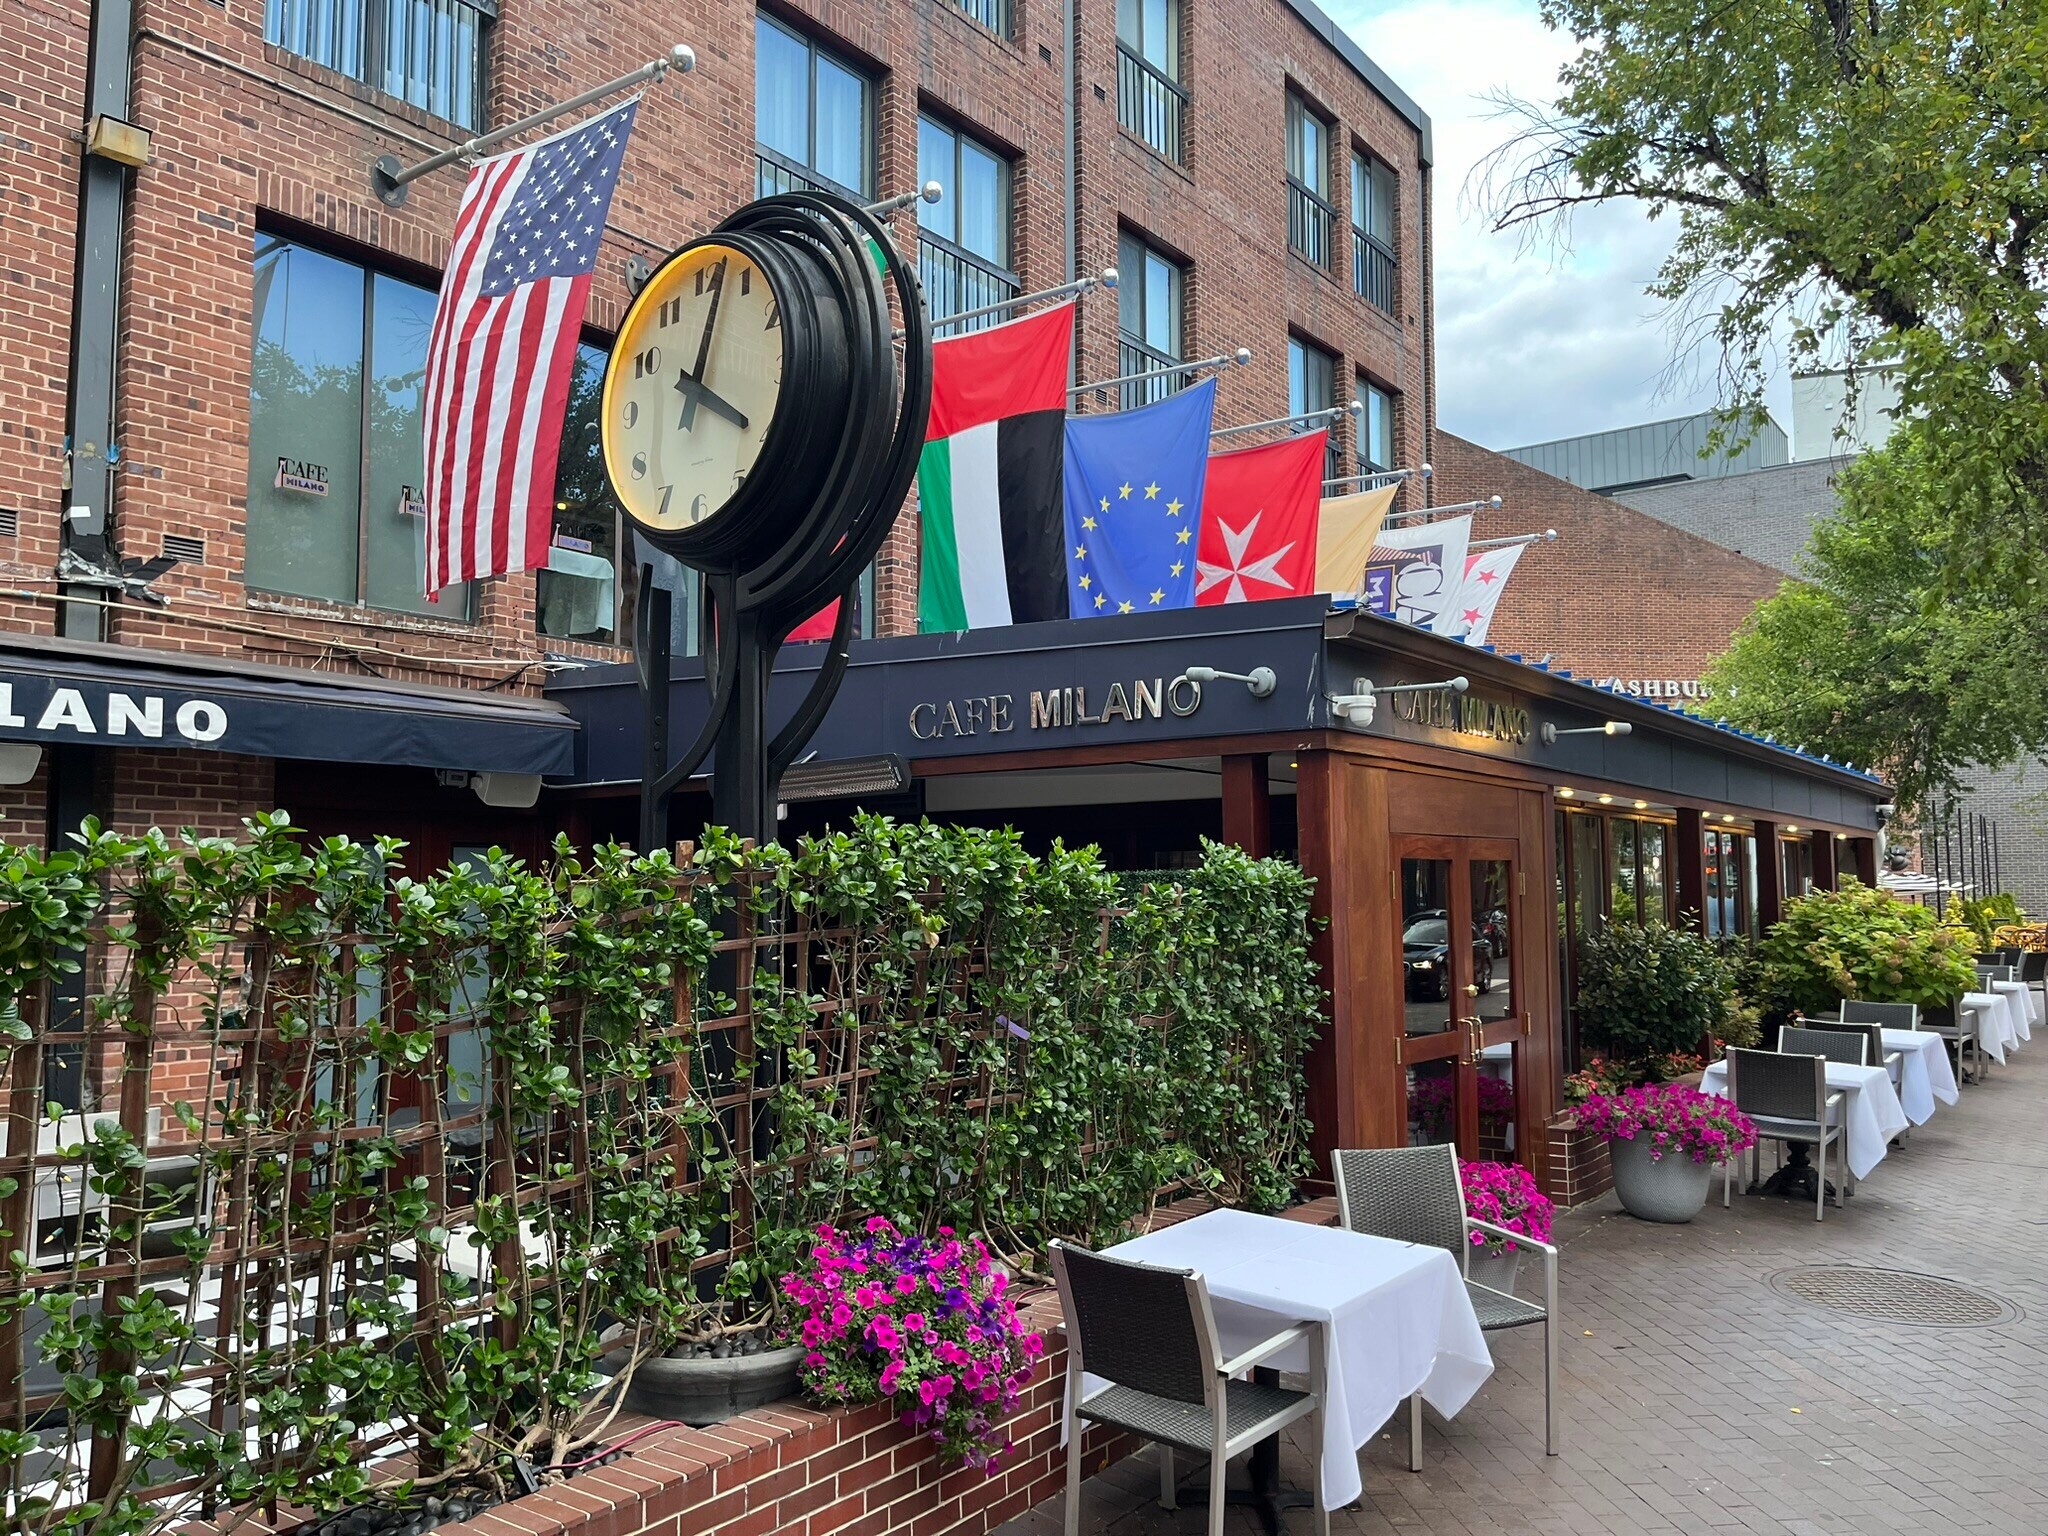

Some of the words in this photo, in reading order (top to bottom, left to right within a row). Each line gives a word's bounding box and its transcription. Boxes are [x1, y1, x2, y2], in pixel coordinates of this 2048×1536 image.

[693, 261, 723, 297] 12
[738, 266, 750, 297] 1
[658, 296, 681, 329] 11
[633, 346, 662, 380] 10
[622, 401, 638, 430] 9
[284, 458, 328, 484] CAFE
[631, 451, 647, 481] 8
[286, 476, 325, 493] MILANO
[658, 484, 674, 515] 7
[690, 493, 709, 523] 6
[909, 694, 1014, 740] CAFE
[1030, 674, 1201, 729] MILANO
